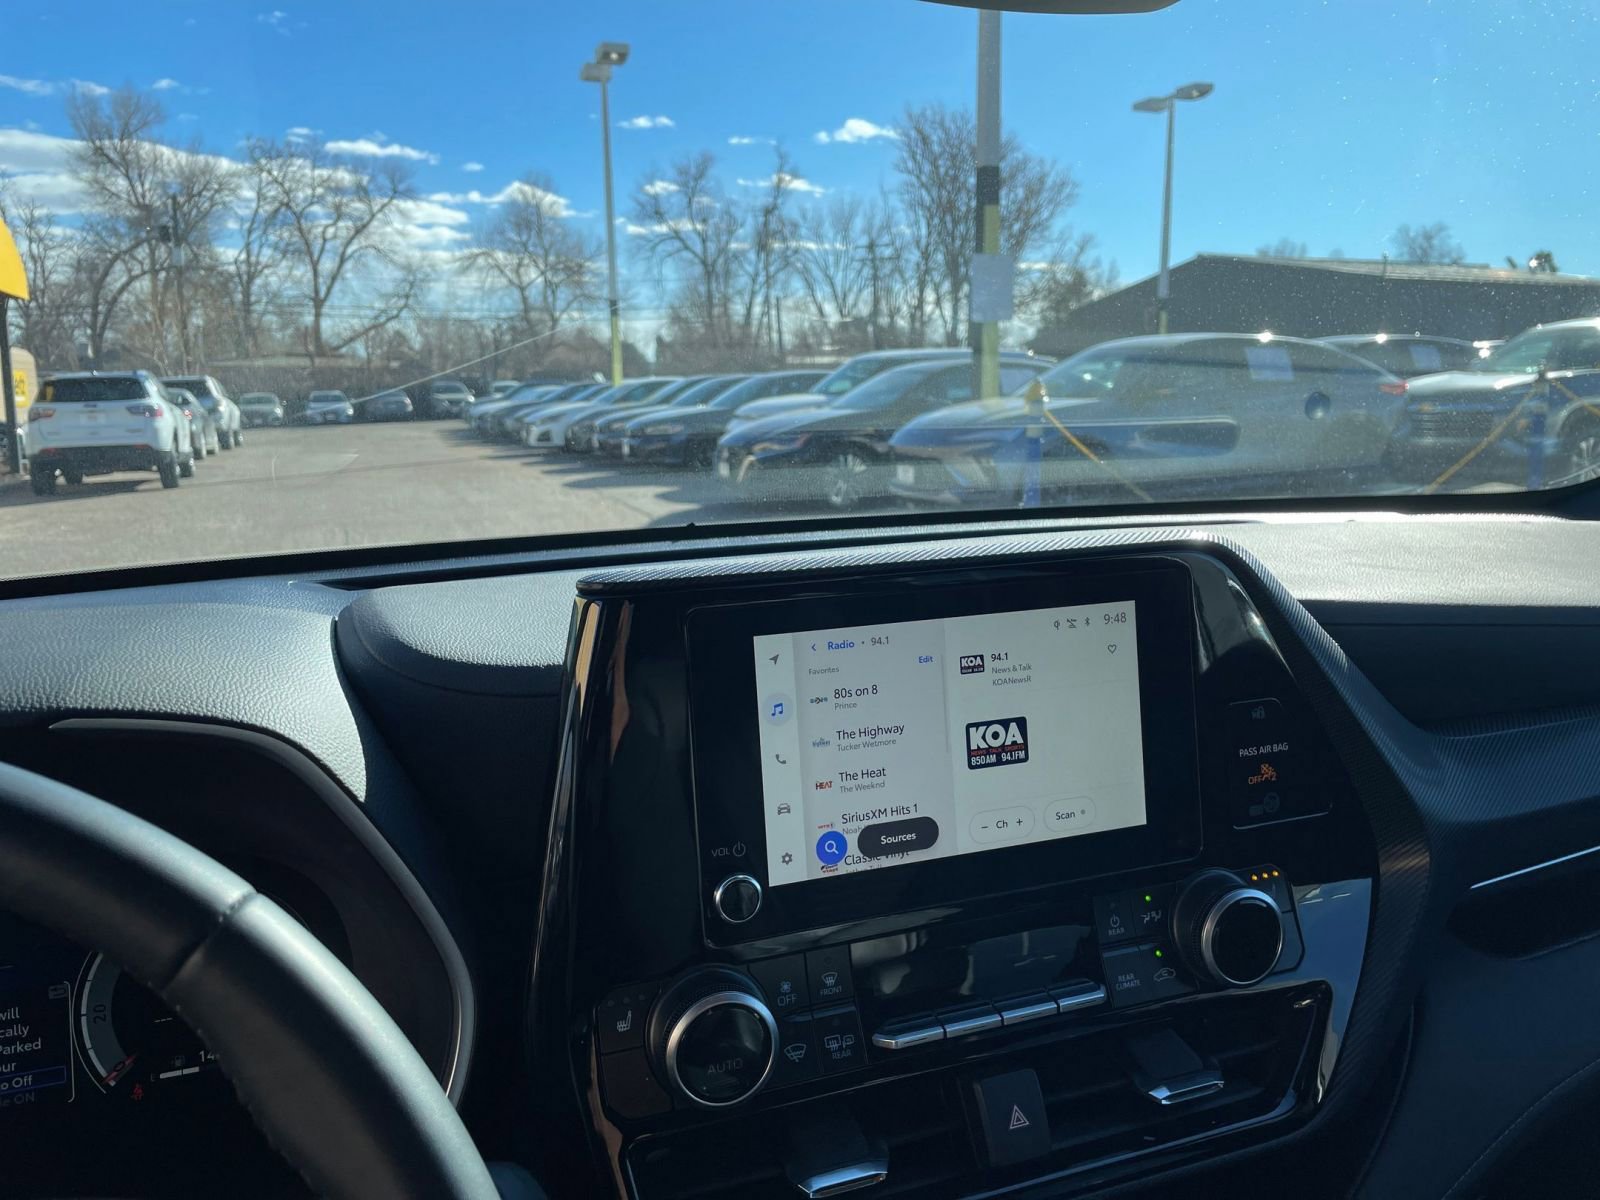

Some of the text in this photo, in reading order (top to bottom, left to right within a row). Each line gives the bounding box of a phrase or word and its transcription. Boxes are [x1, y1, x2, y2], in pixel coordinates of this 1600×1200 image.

[1104, 612, 1127, 625] 9:48
[827, 636, 889, 651] Radio 94.1
[918, 655, 934, 664] Edit
[961, 656, 983, 667] KOA
[990, 652, 1009, 662] 94.1
[808, 666, 840, 676] Favorites
[991, 667, 1011, 675] News
[1012, 665, 1018, 673] &
[1018, 663, 1032, 672] Talk
[992, 675, 1032, 686] KOANewsR
[834, 684, 878, 699] 80s on 8
[834, 701, 858, 711] Prince
[836, 725, 905, 741] The Highway
[969, 722, 1024, 750] KOA
[837, 742, 861, 752] Tucker
[862, 739, 897, 749] Wetmore
[1239, 742, 1289, 758] PASS AIR BAG
[971, 750, 1026, 766] 850AM 94.1FM
[838, 767, 887, 782] The Heat
[1248, 775, 1262, 785] OFF
[815, 780, 833, 790] HEAT
[840, 781, 886, 794] The Weeknd
[841, 803, 919, 825] SiriusXM Hits 1
[1055, 811, 1076, 821] Scan
[996, 820, 1008, 829] Ch
[880, 832, 917, 845] Sources
[711, 847, 730, 857] VOL
[1108, 927, 1125, 936] REAR
[1117, 973, 1135, 982] REAR
[820, 985, 842, 996] FRONT
[1116, 979, 1141, 991] CLIMATE
[777, 993, 798, 1006] OFF
[93, 1004, 107, 1024] 20
[832, 1048, 852, 1060] REAR
[707, 1057, 744, 1073] AUTO
[12, 1074, 33, 1088] Off
[14, 1091, 35, 1105] ON
